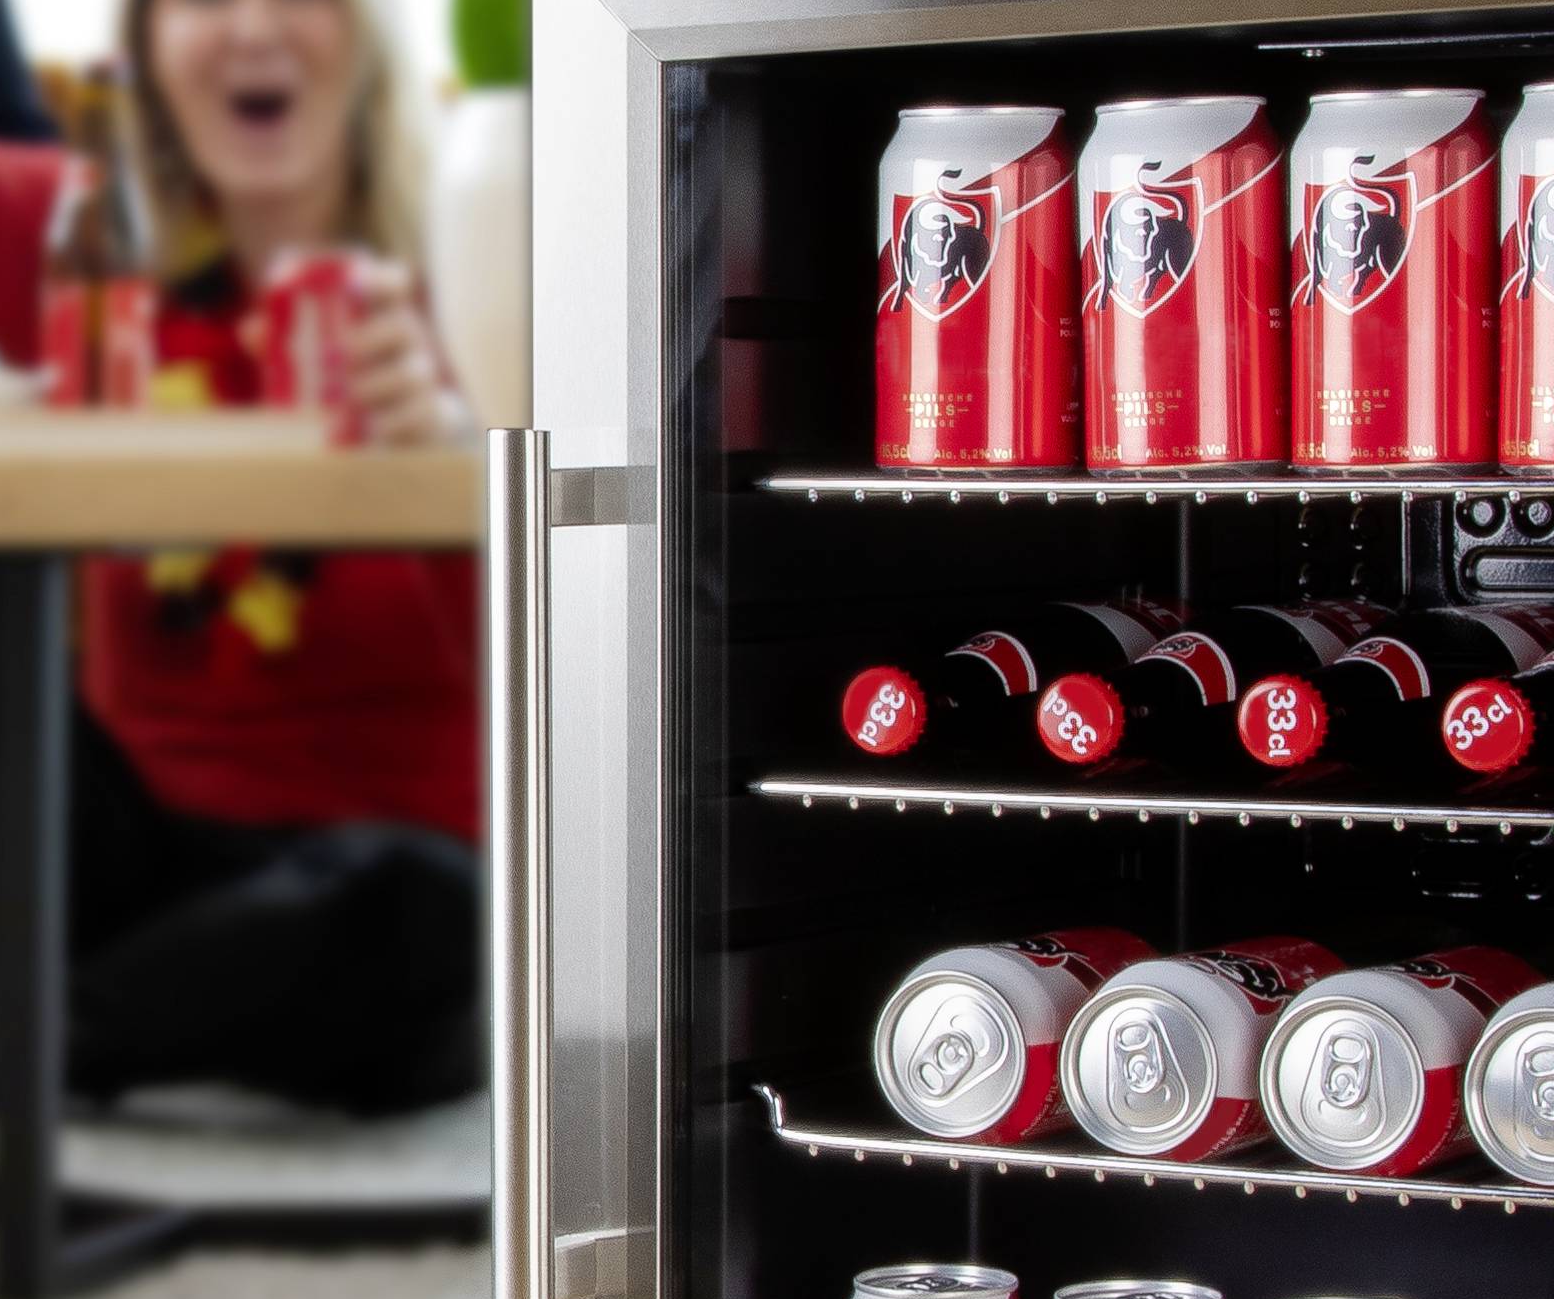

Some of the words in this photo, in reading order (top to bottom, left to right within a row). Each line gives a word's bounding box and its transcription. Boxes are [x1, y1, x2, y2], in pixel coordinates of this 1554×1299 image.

[993, 448, 1016, 459] Vol.
[1206, 444, 1231, 456] Vol.
[1412, 445, 1437, 456] Vol.
[858, 683, 906, 746] 33cl
[1043, 690, 1097, 754] 33cl
[1267, 688, 1297, 758] 33cl
[1447, 693, 1513, 750] 33cl
